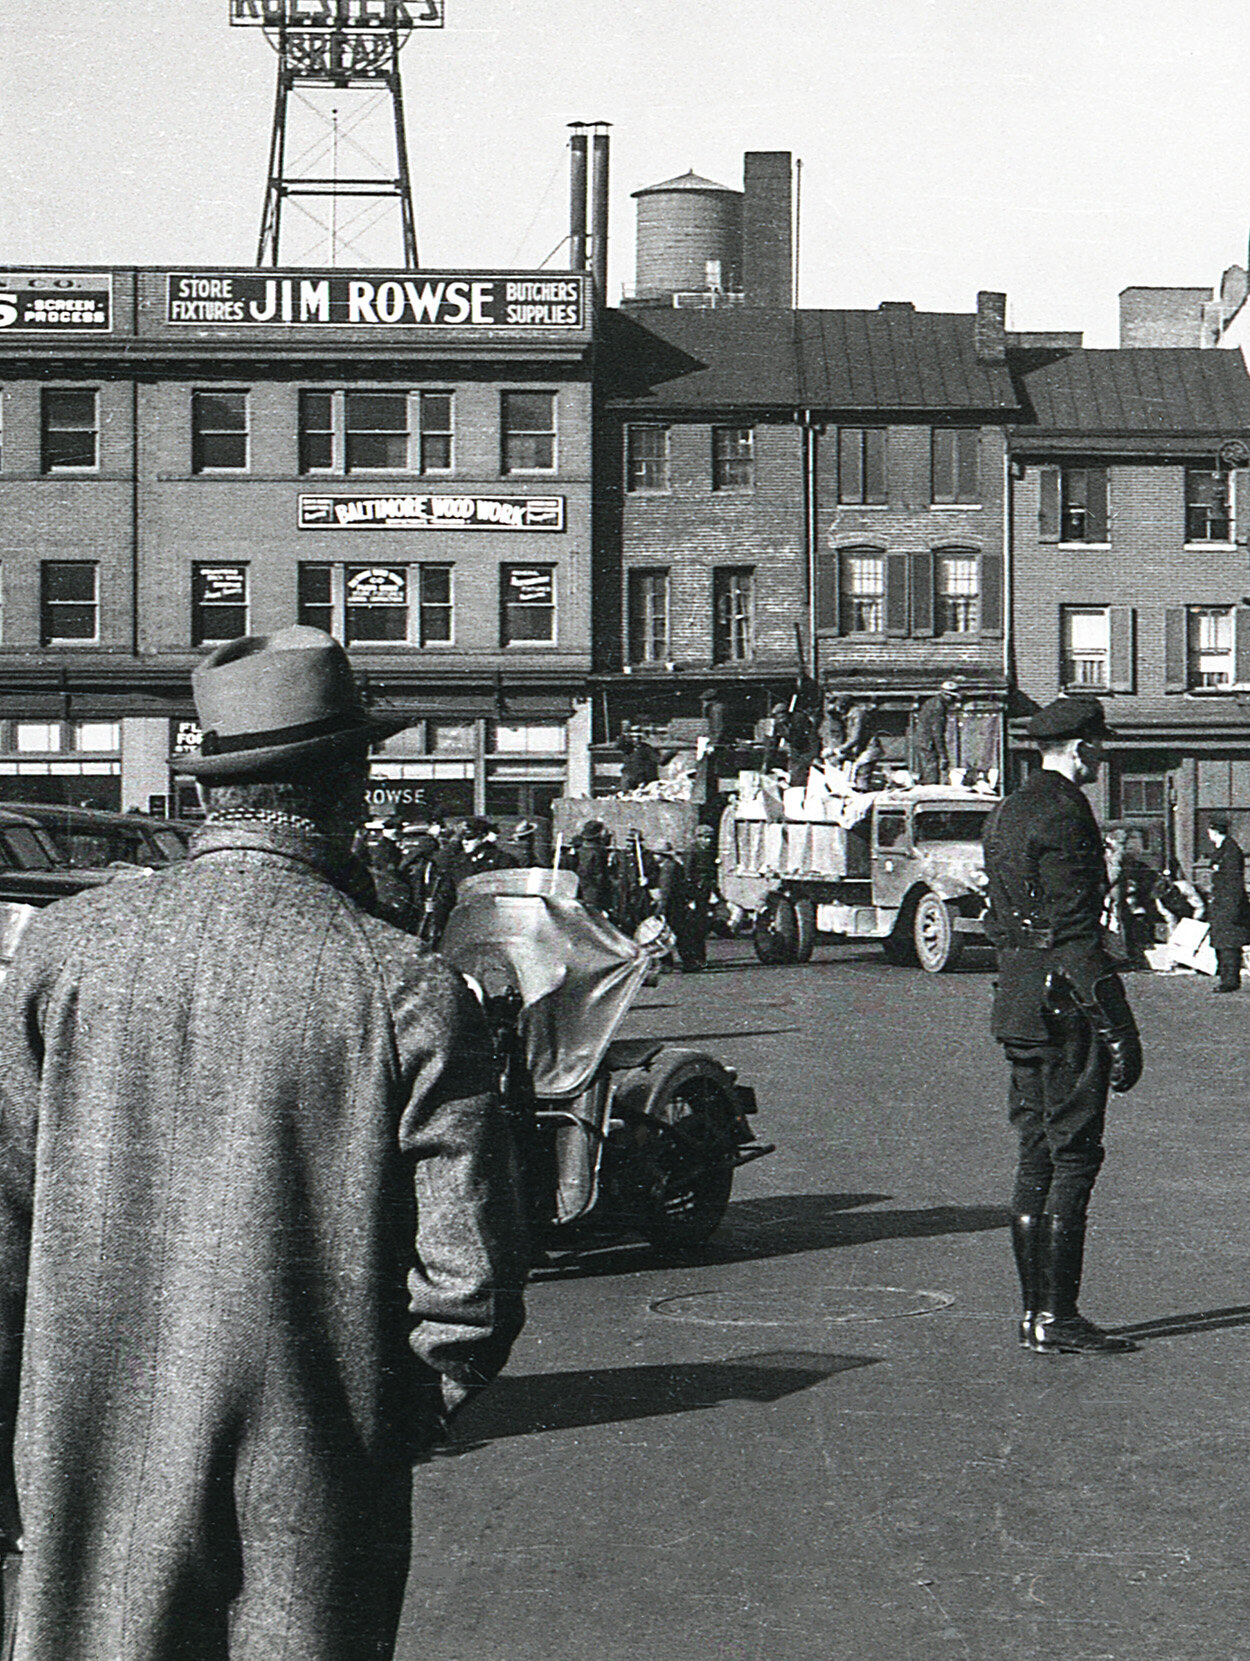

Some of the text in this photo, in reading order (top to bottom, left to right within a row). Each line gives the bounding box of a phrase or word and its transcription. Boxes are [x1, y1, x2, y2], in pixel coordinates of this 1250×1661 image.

[179, 280, 233, 298] STORE
[506, 282, 577, 301] BUTCHERS
[33, 299, 95, 311] SCREEN
[172, 301, 244, 320] FIXTURES
[250, 280, 494, 323] JIM ROWSE
[24, 311, 105, 323] PROCESS
[506, 304, 577, 323] SUPPLIES
[335, 498, 427, 524] BALTIMORE
[431, 498, 475, 518] WOOD
[477, 500, 527, 526] WORK
[179, 722, 203, 733] FL
